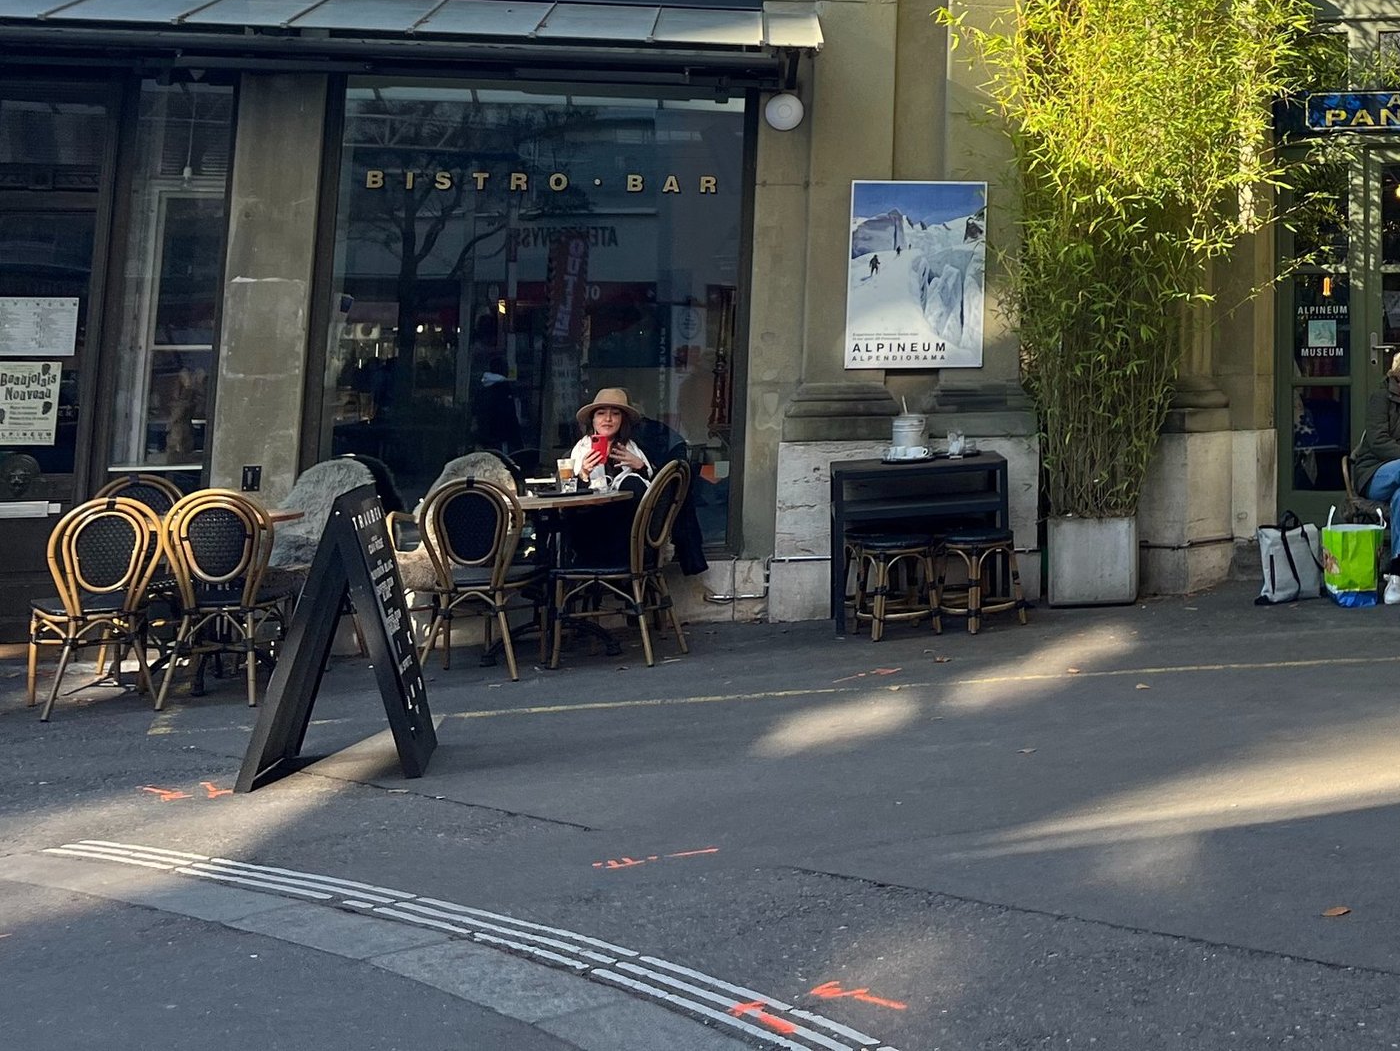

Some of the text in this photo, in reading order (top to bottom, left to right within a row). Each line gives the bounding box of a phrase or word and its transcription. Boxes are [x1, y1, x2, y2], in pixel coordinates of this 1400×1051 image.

[365, 170, 569, 191] BISTRO
[626, 174, 718, 193] BAR
[1297, 305, 1348, 315] ALPINEUM
[852, 342, 946, 353] ALPINEUM
[1301, 348, 1344, 357] MUSEUM
[852, 354, 946, 362] ALPENDIORAMA
[0, 372, 57, 388] Beaujolais
[5, 387, 51, 400] Nouveau
